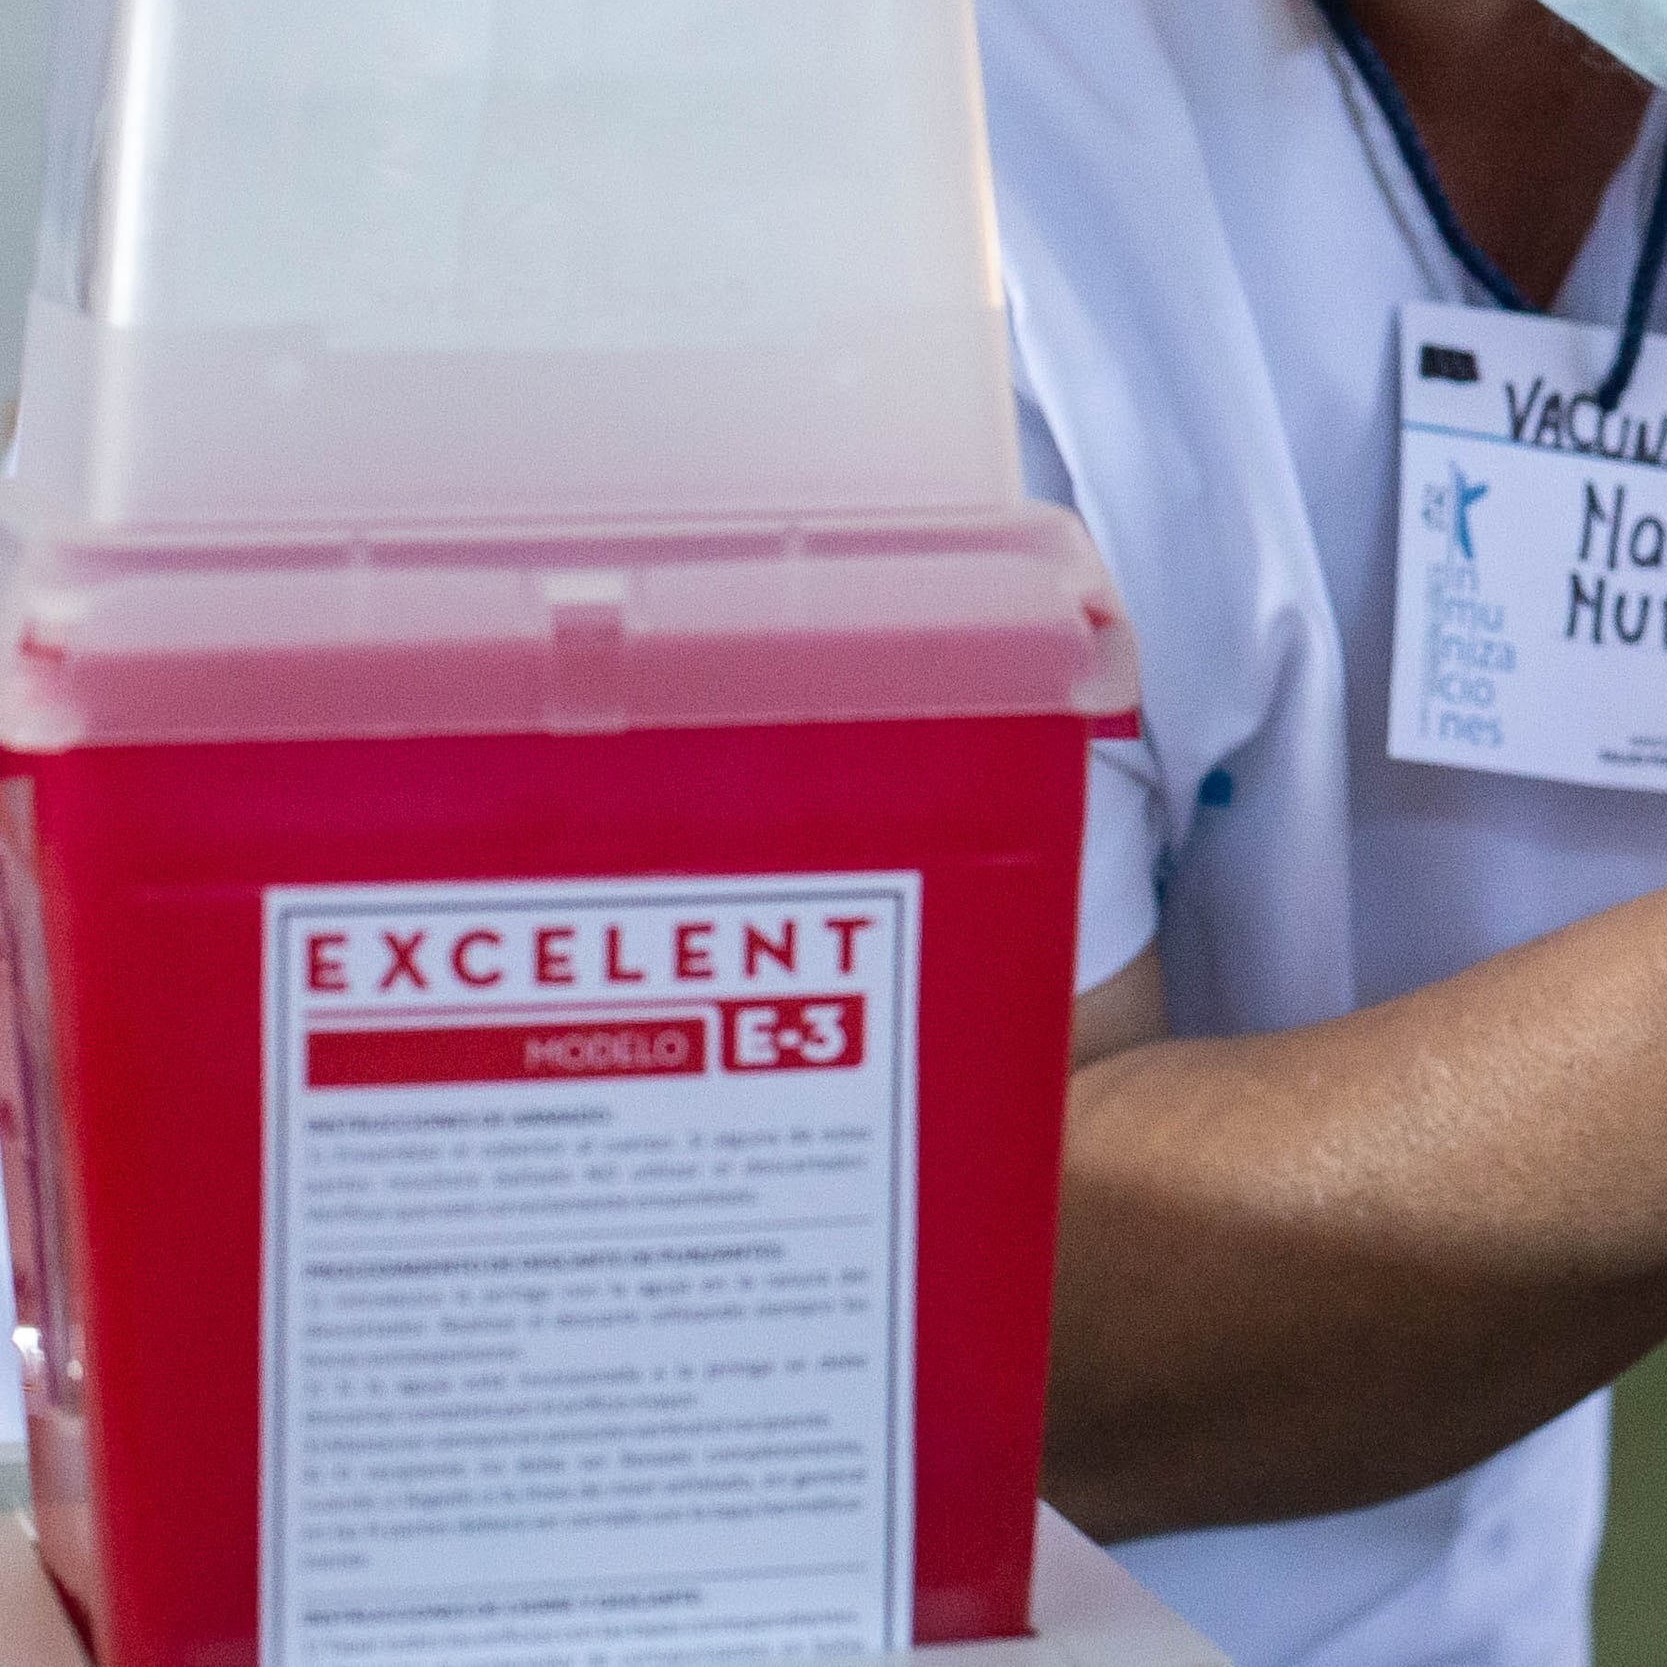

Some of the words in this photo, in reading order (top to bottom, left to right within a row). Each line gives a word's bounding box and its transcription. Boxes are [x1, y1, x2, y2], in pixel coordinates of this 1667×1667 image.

[304, 918, 876, 994] EXCELENT
[523, 1027, 690, 1071] MODELO
[731, 1004, 850, 1068] E-3
